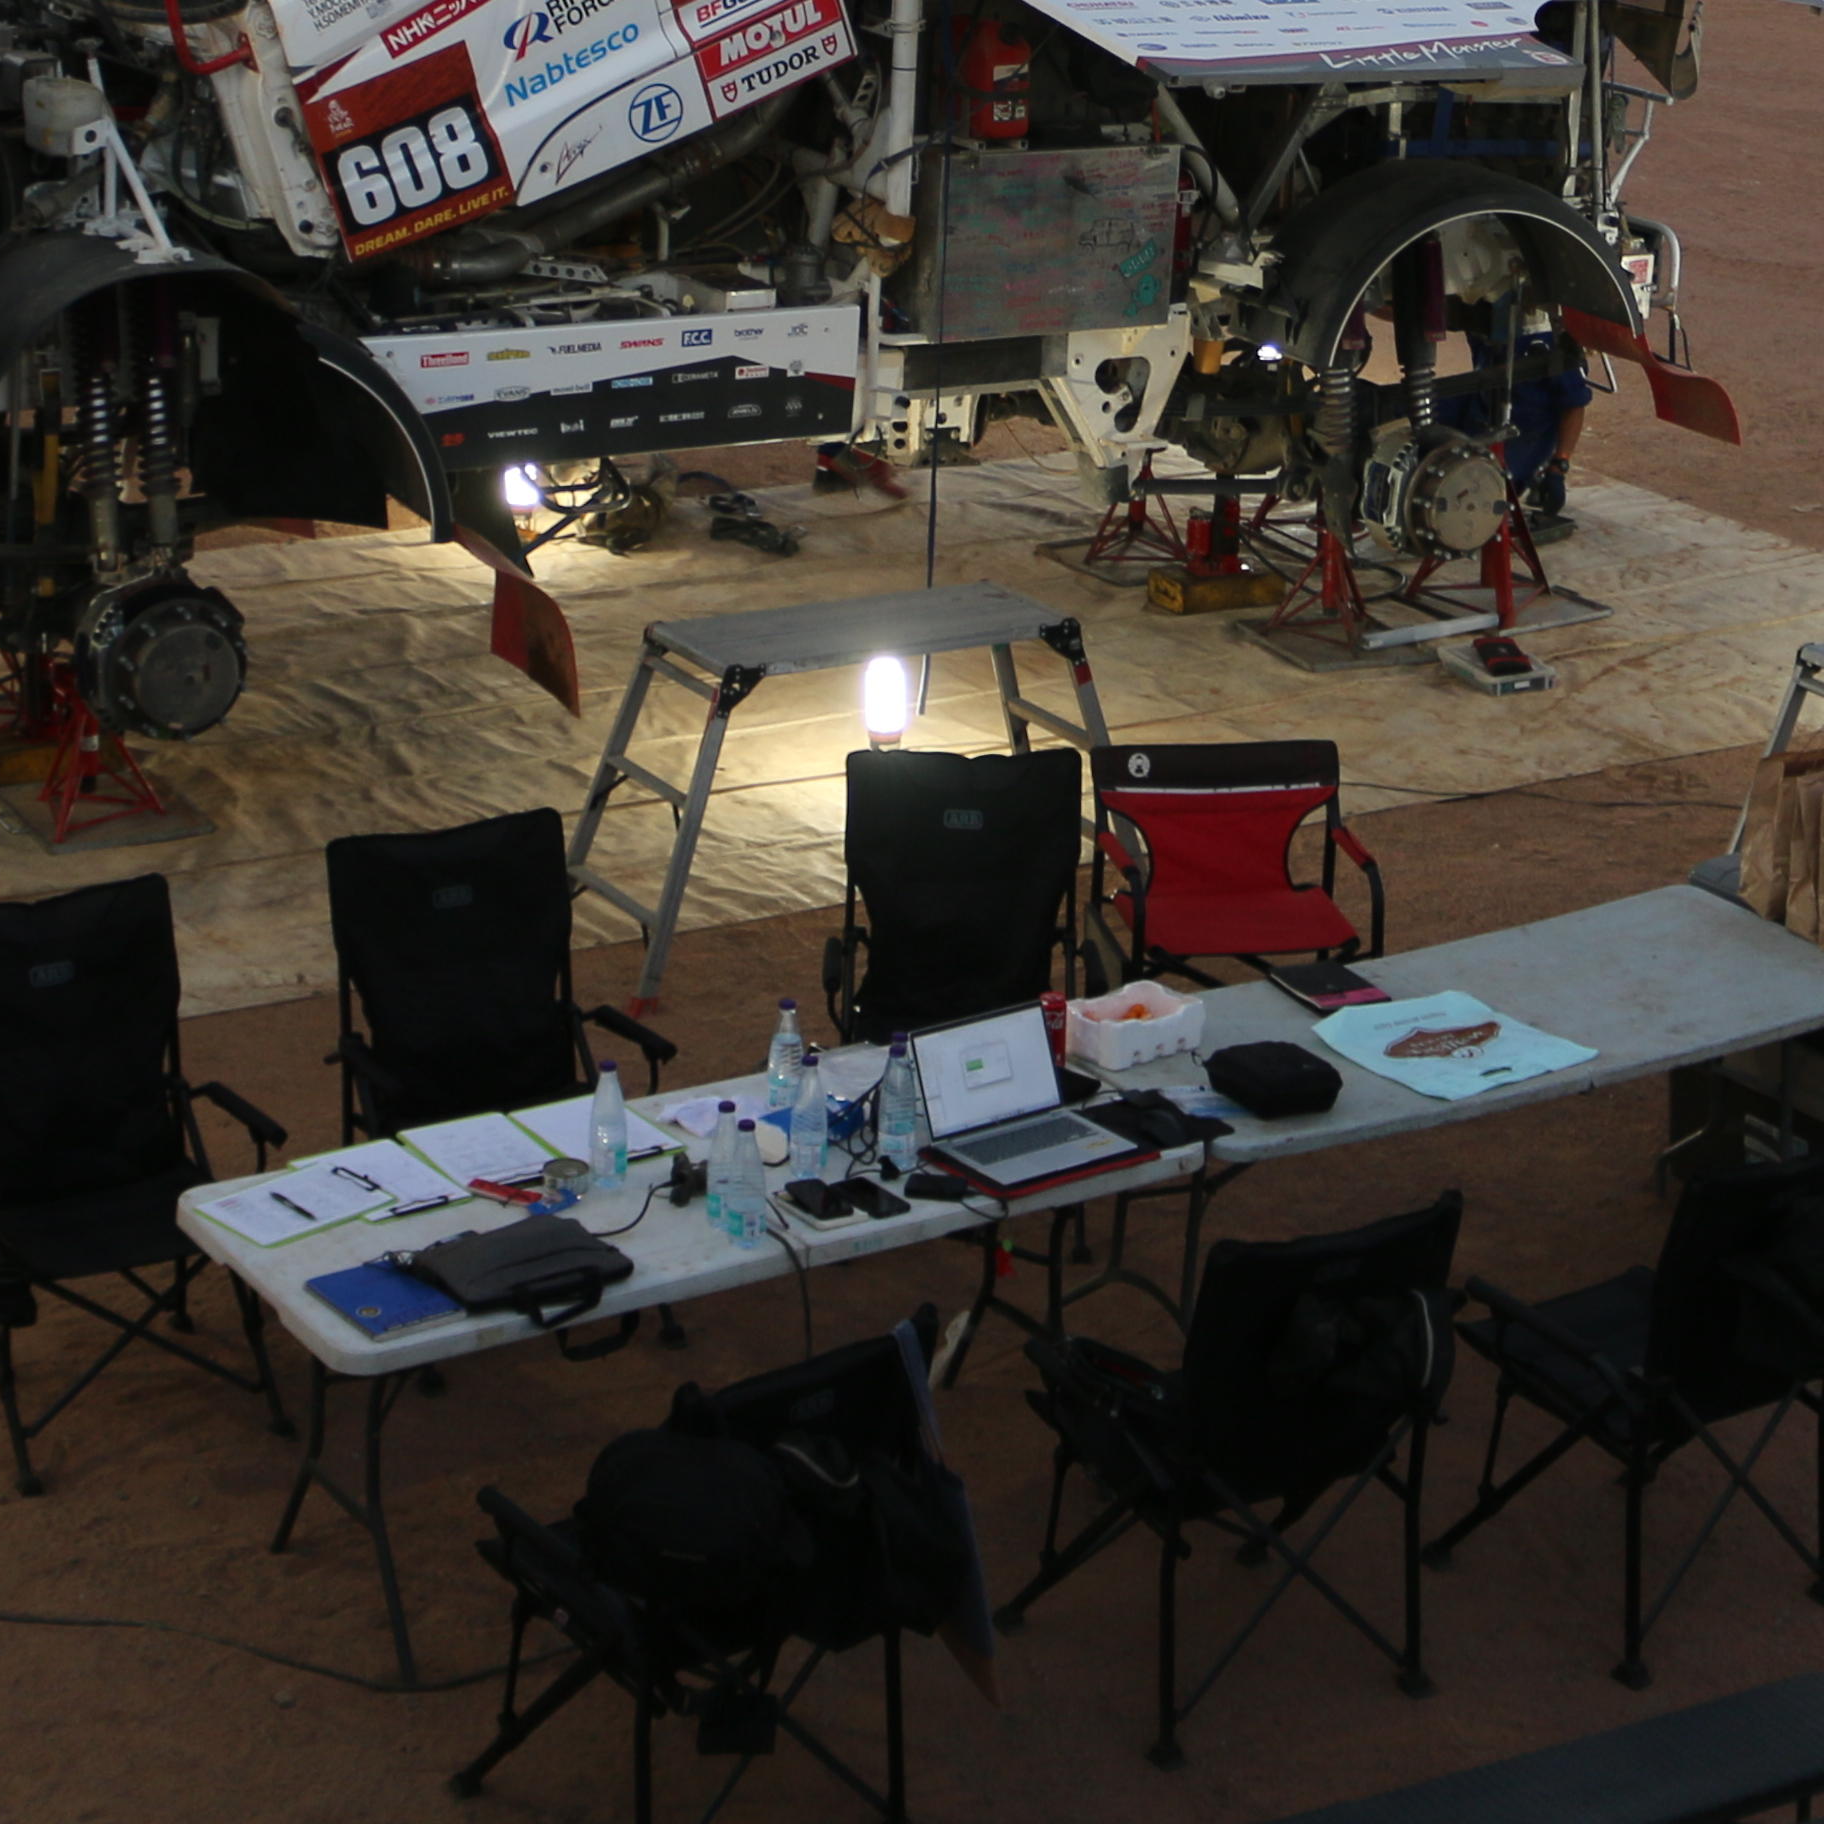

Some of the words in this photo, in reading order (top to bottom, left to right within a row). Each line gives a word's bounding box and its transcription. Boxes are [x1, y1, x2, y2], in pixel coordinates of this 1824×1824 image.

[504, 23, 640, 108] Nabtesco
[740, 45, 821, 94] TUDOR
[632, 88, 683, 136] ZF
[336, 104, 490, 228] 608
[354, 228, 412, 257] DREAM.
[413, 209, 457, 234] DARE.
[458, 192, 491, 216] LIVE
[491, 185, 510, 200] IT.
